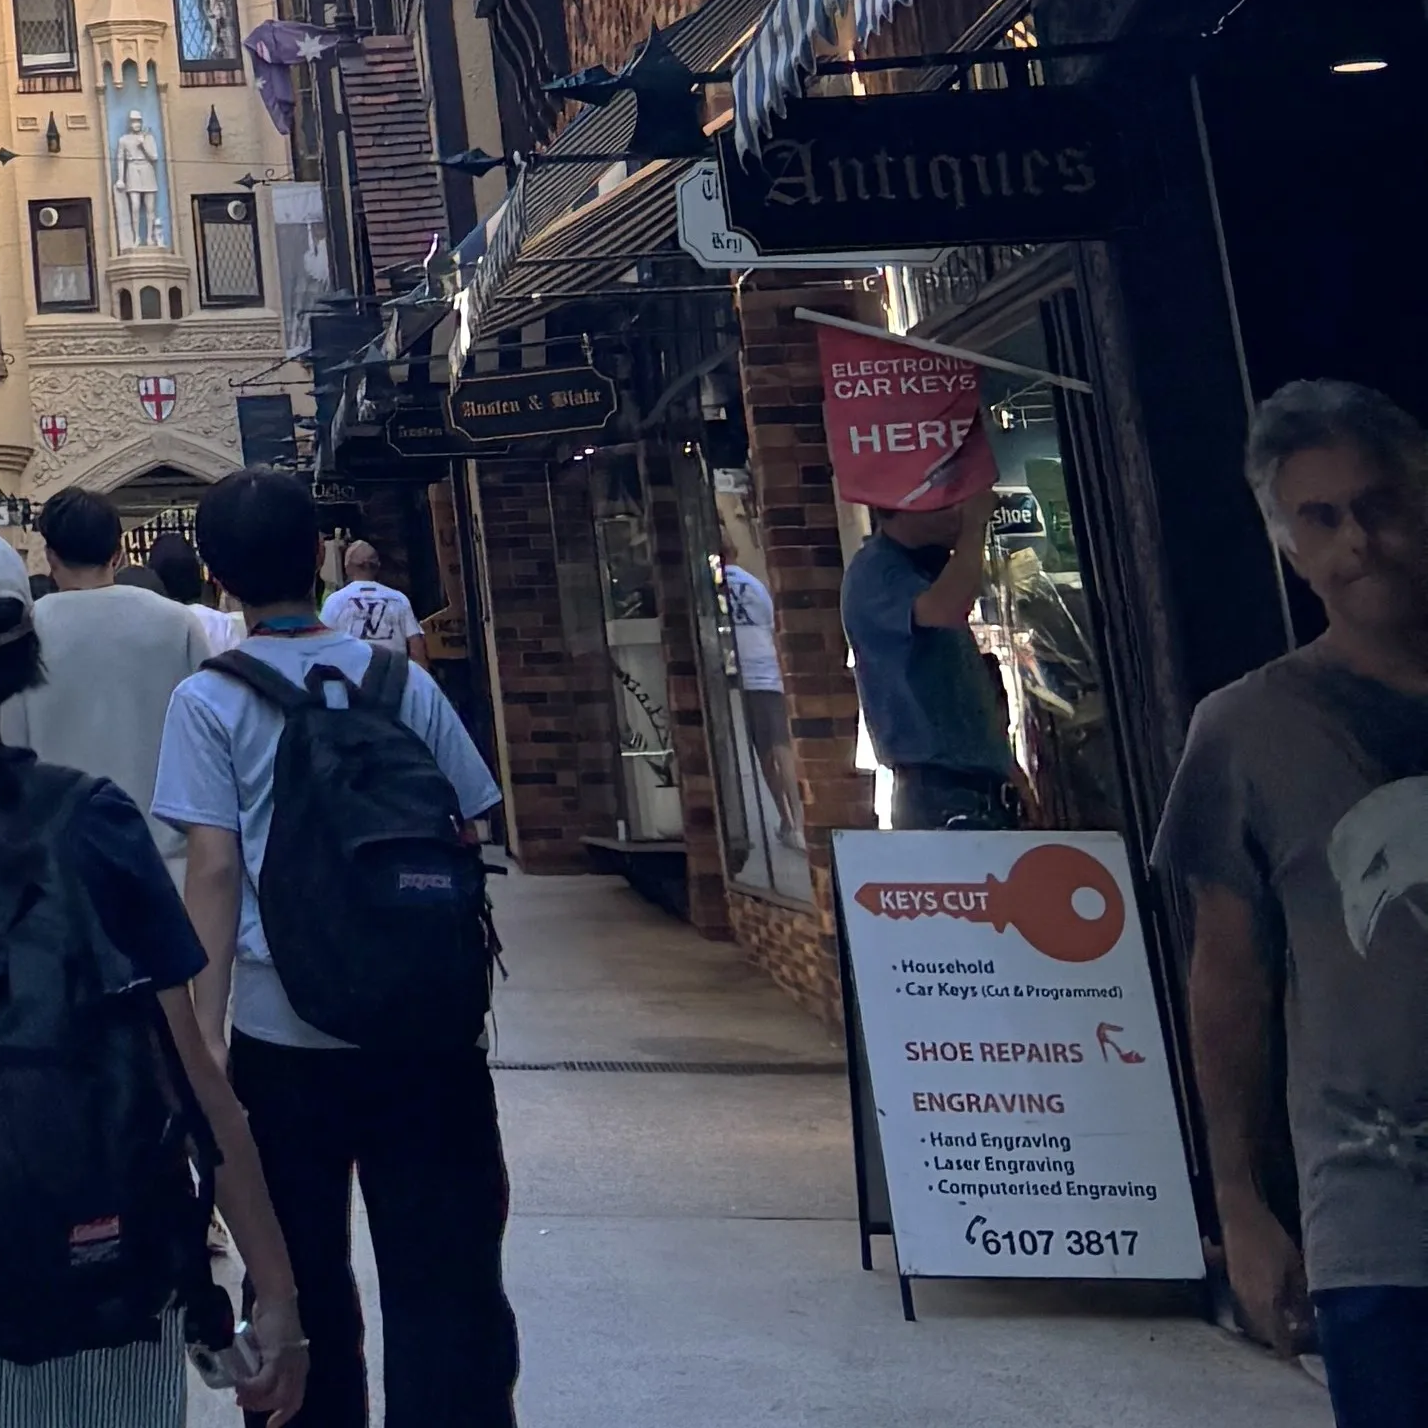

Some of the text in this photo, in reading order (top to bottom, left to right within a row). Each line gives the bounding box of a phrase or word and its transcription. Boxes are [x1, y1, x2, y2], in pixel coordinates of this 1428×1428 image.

[761, 138, 1098, 210] Antiques
[831, 357, 975, 379] ELECTRONIC
[834, 373, 977, 400] CAR KEYS
[528, 393, 544, 411] &
[992, 506, 1033, 525] shoe
[879, 887, 990, 913] KEYS CUT
[901, 957, 996, 976] Household
[905, 982, 1124, 1002] Car Keys (Cut & Programmed)
[905, 1041, 1084, 1065] SHOE REPAIRS
[912, 1091, 1066, 1115] ENGRAVING
[930, 1131, 1072, 1153] Hand Engraving
[934, 1156, 1076, 1177] Laser Engraving
[937, 1179, 1158, 1201] Computerised Engraving
[981, 1230, 1140, 1257] 6107 3817
